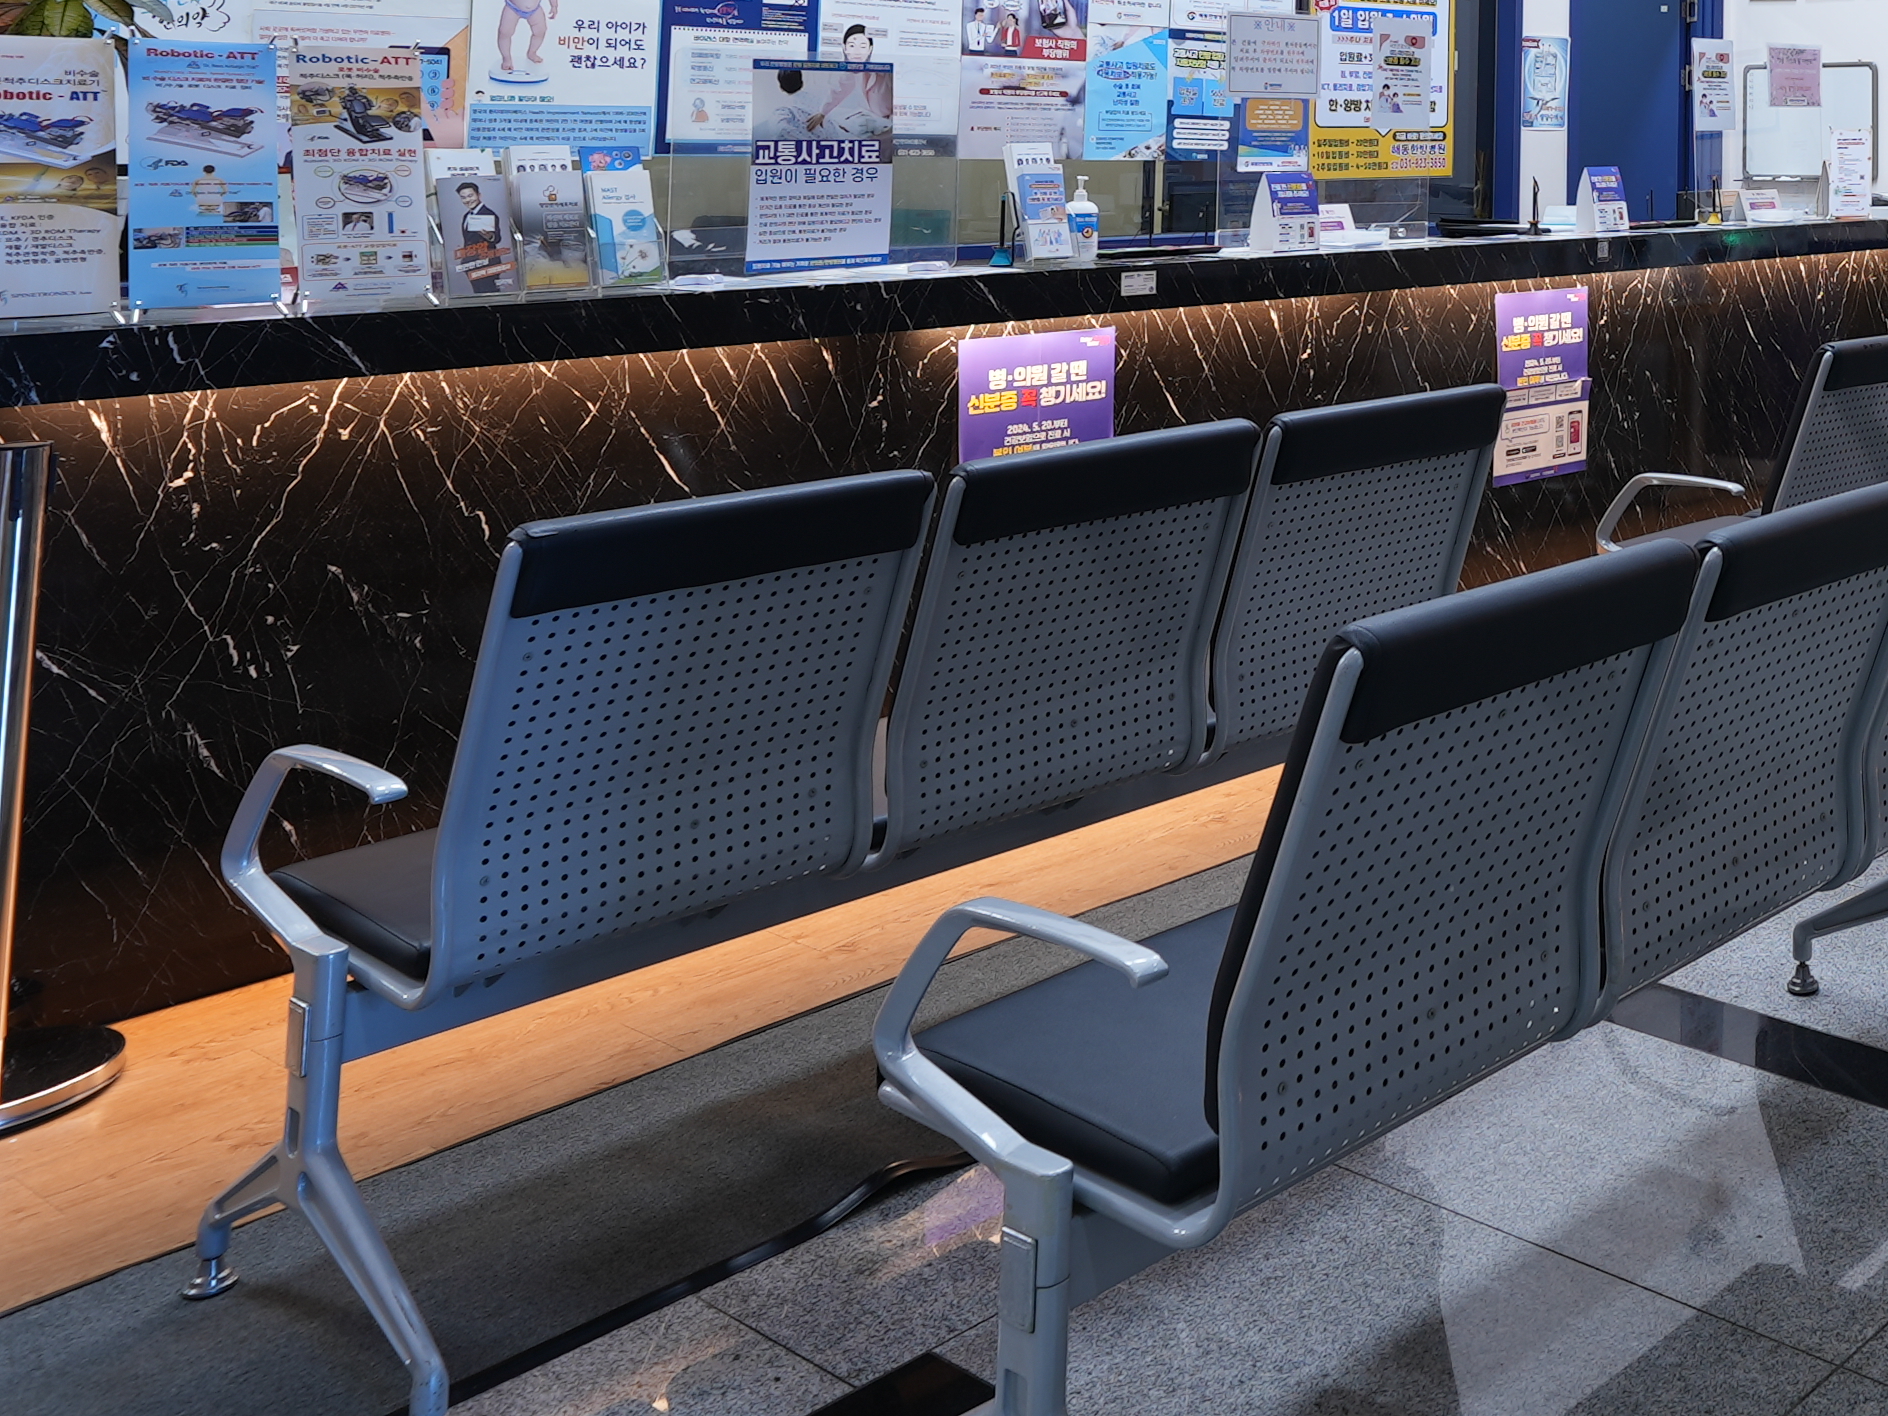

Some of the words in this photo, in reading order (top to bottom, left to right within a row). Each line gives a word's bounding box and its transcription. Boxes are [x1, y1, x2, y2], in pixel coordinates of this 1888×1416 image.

[573, 19, 600, 33] 우리
[605, 20, 648, 35] 아이가
[1332, 9, 1353, 29] 1일
[558, 36, 599, 51] 비만이
[605, 37, 646, 51] 되어도
[146, 48, 215, 59] Robotic
[225, 51, 259, 61] ATT
[568, 54, 647, 70] 괜찮으세요?
[69, 90, 100, 102] ATT
[754, 139, 881, 165] 교통사고치료
[754, 168, 798, 185] 입원이
[803, 167, 847, 184] 필요한
[851, 167, 879, 183] 경우
[1512, 314, 1549, 334] 병·의원
[1549, 313, 1561, 330] 갈
[1561, 312, 1572, 328] 땐
[1501, 334, 1531, 352] 신분증
[1532, 332, 1543, 347] 꼭
[1543, 328, 1584, 347] 챙기세요!
[988, 364, 1049, 391] 병·의원
[1050, 362, 1069, 384] 갈
[1069, 360, 1088, 381] 땐
[967, 390, 1018, 415] 신분증
[1021, 388, 1038, 407] 꼭
[1039, 380, 1107, 407] 챙기세요!
[1006, 423, 1031, 435] 2024.
